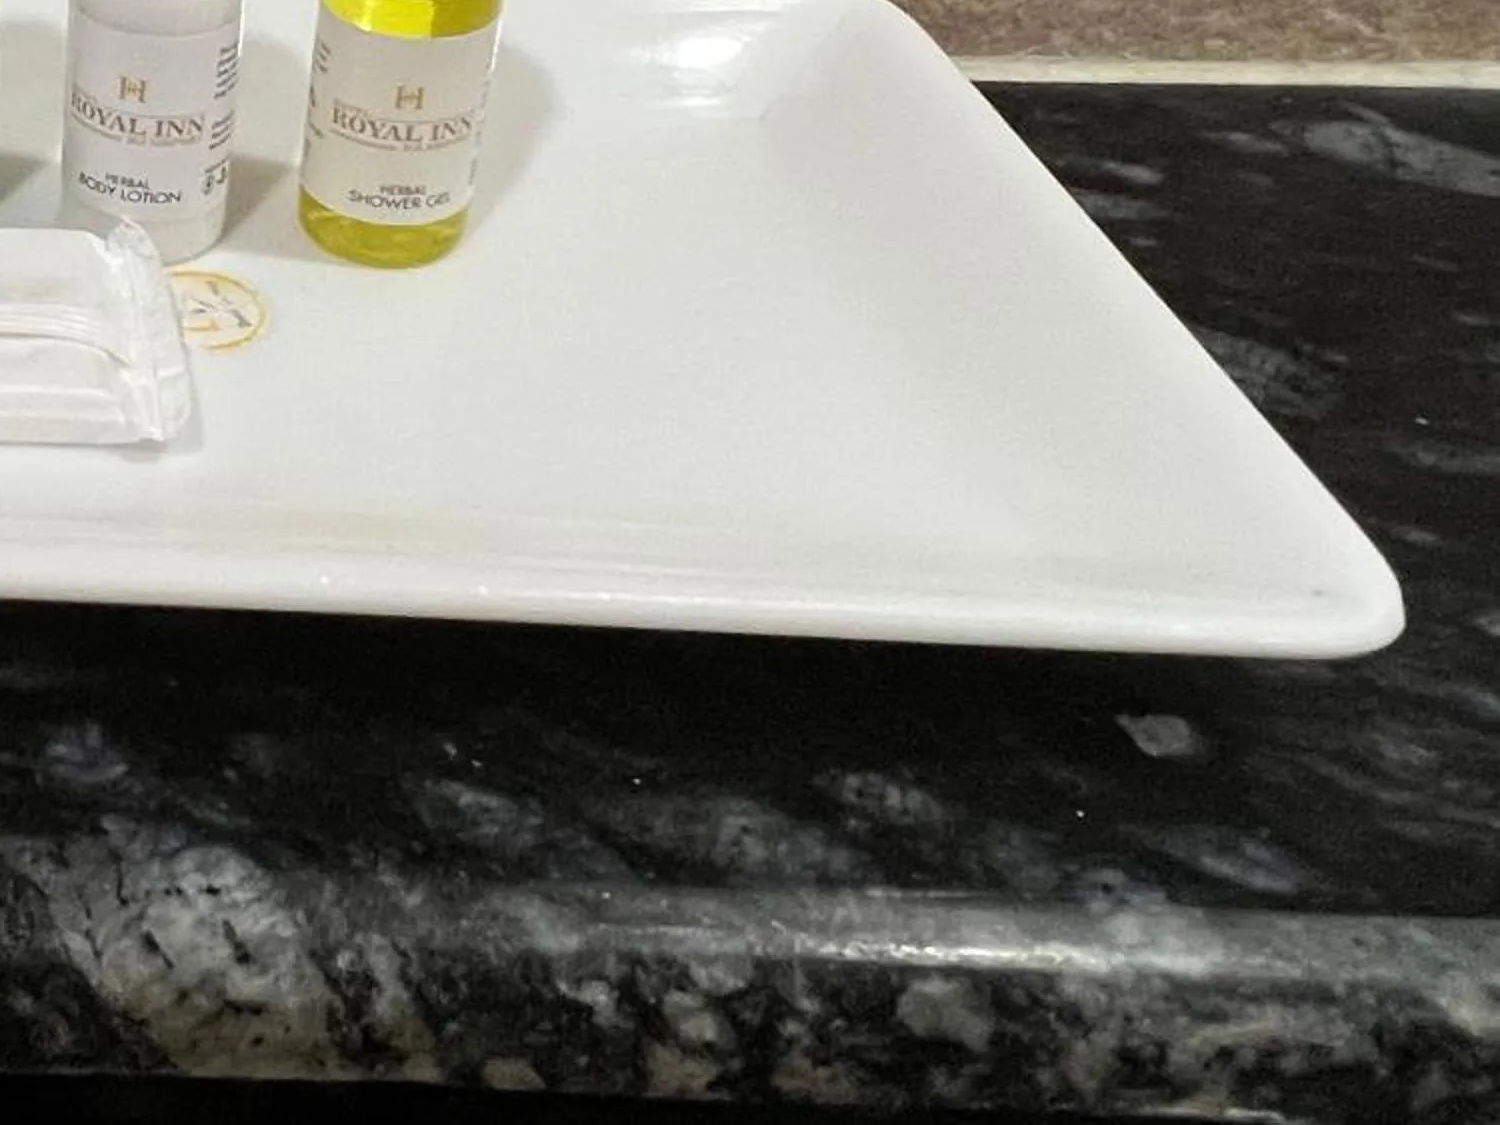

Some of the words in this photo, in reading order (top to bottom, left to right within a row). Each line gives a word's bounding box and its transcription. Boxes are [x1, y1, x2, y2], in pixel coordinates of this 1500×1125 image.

[71, 91, 147, 136] ROYAL
[155, 116, 205, 137] INN
[332, 105, 422, 142] ROYAL
[428, 116, 473, 141] INN
[78, 172, 116, 196] BODY
[120, 188, 182, 204] LOTION
[106, 172, 149, 189] HERBAL
[379, 184, 427, 196] HERBAL
[348, 189, 421, 210] SHOWER
[425, 192, 451, 208] GEL
